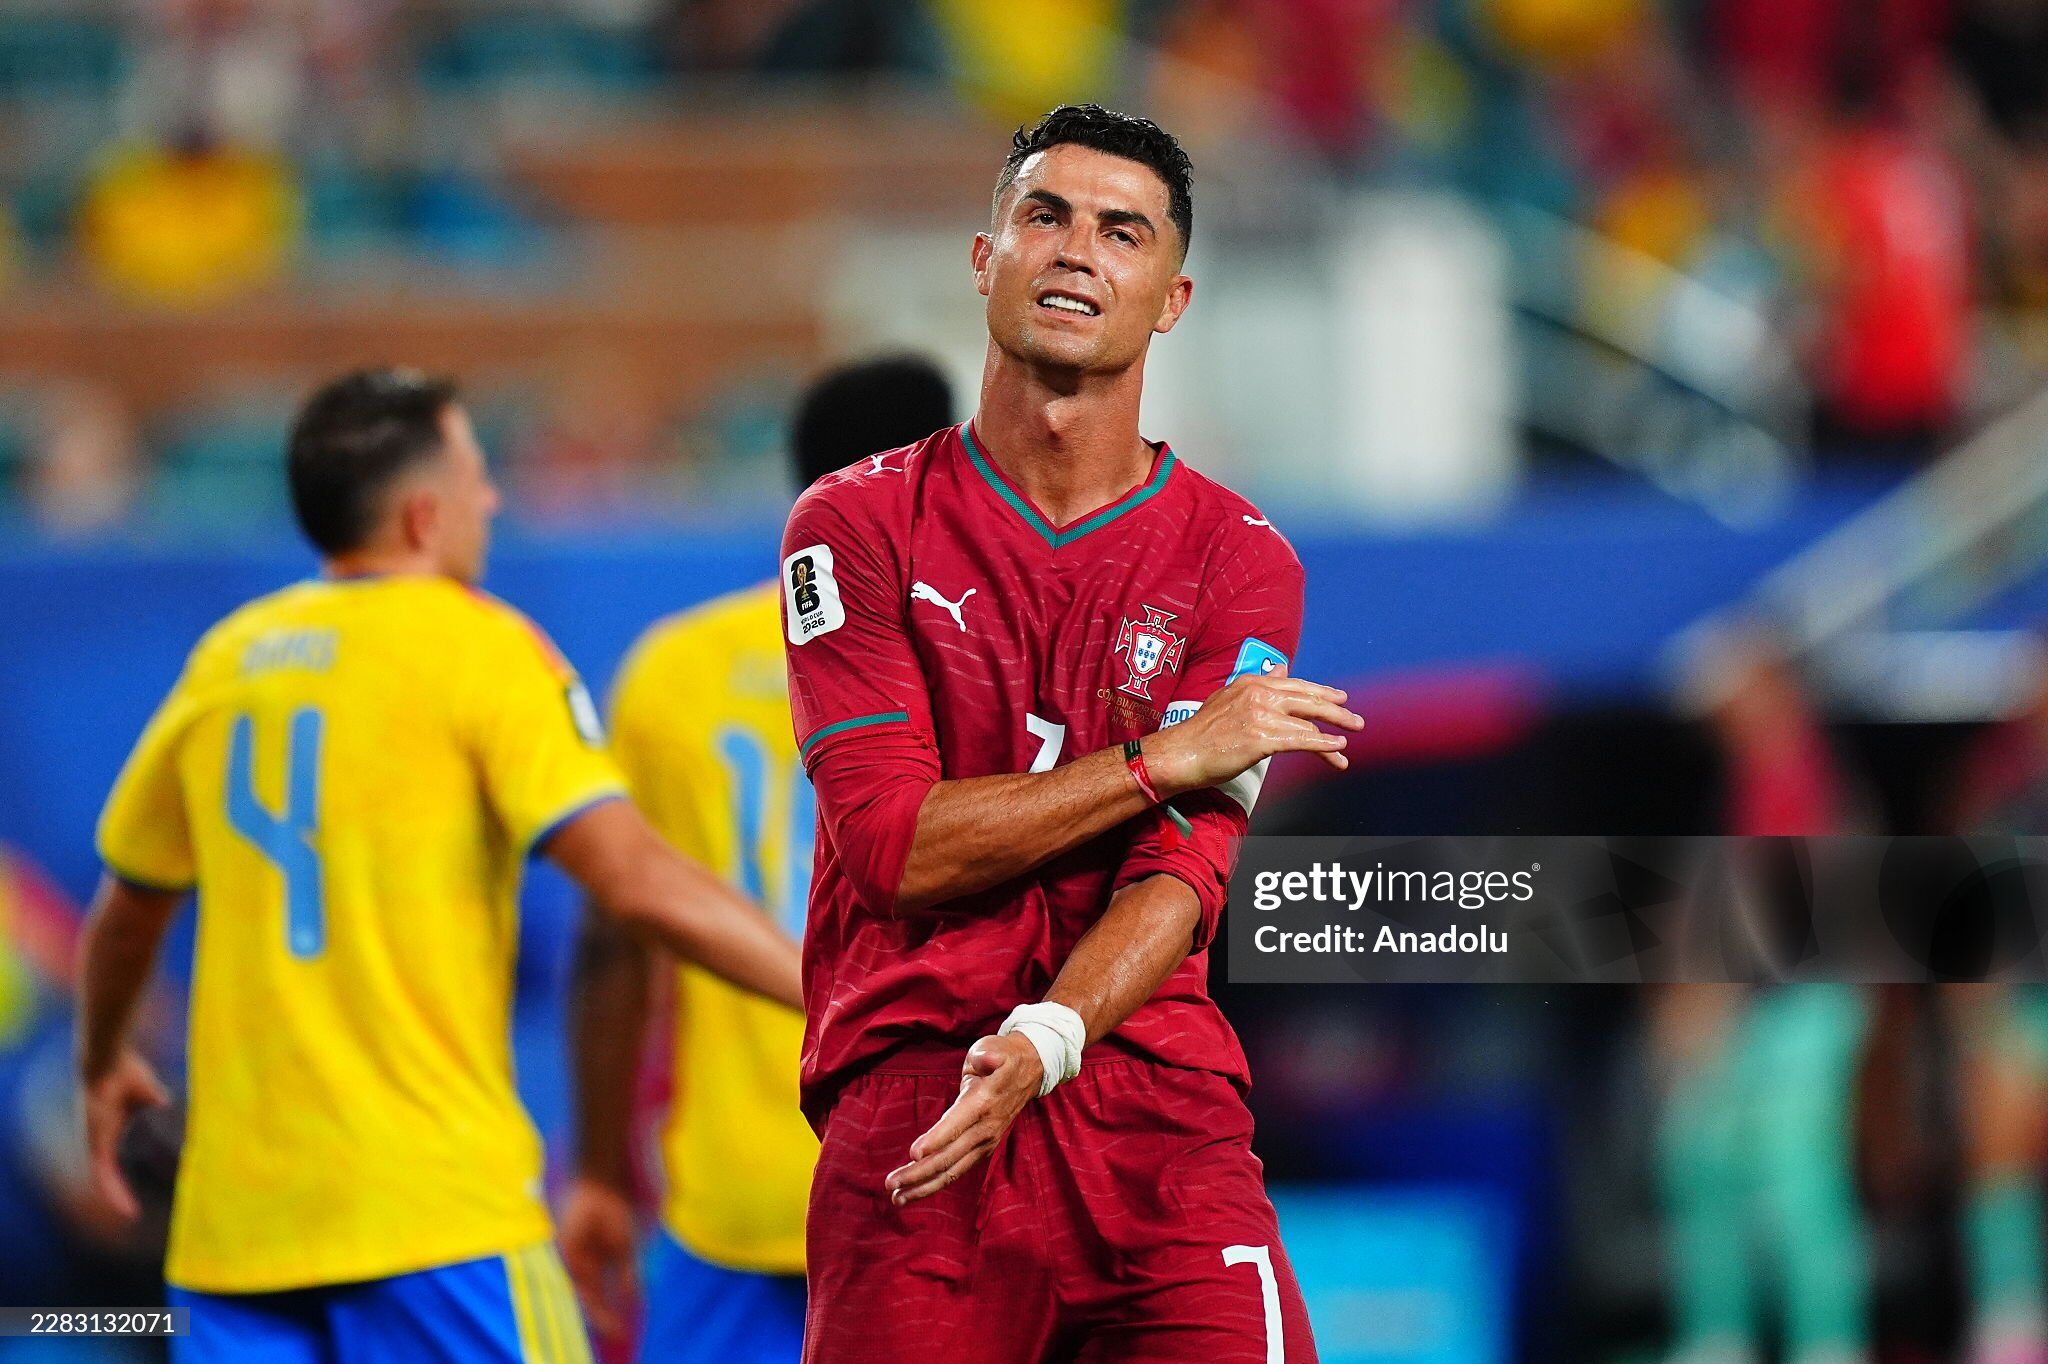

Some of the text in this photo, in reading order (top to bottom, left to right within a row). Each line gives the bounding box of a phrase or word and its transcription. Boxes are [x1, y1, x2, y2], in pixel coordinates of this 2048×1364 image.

[801, 600, 814, 610] FIFA
[802, 617, 826, 634] 2026
[1026, 712, 1066, 774] 7
[225, 706, 325, 957] 4
[1221, 1244, 1285, 1364] 7
